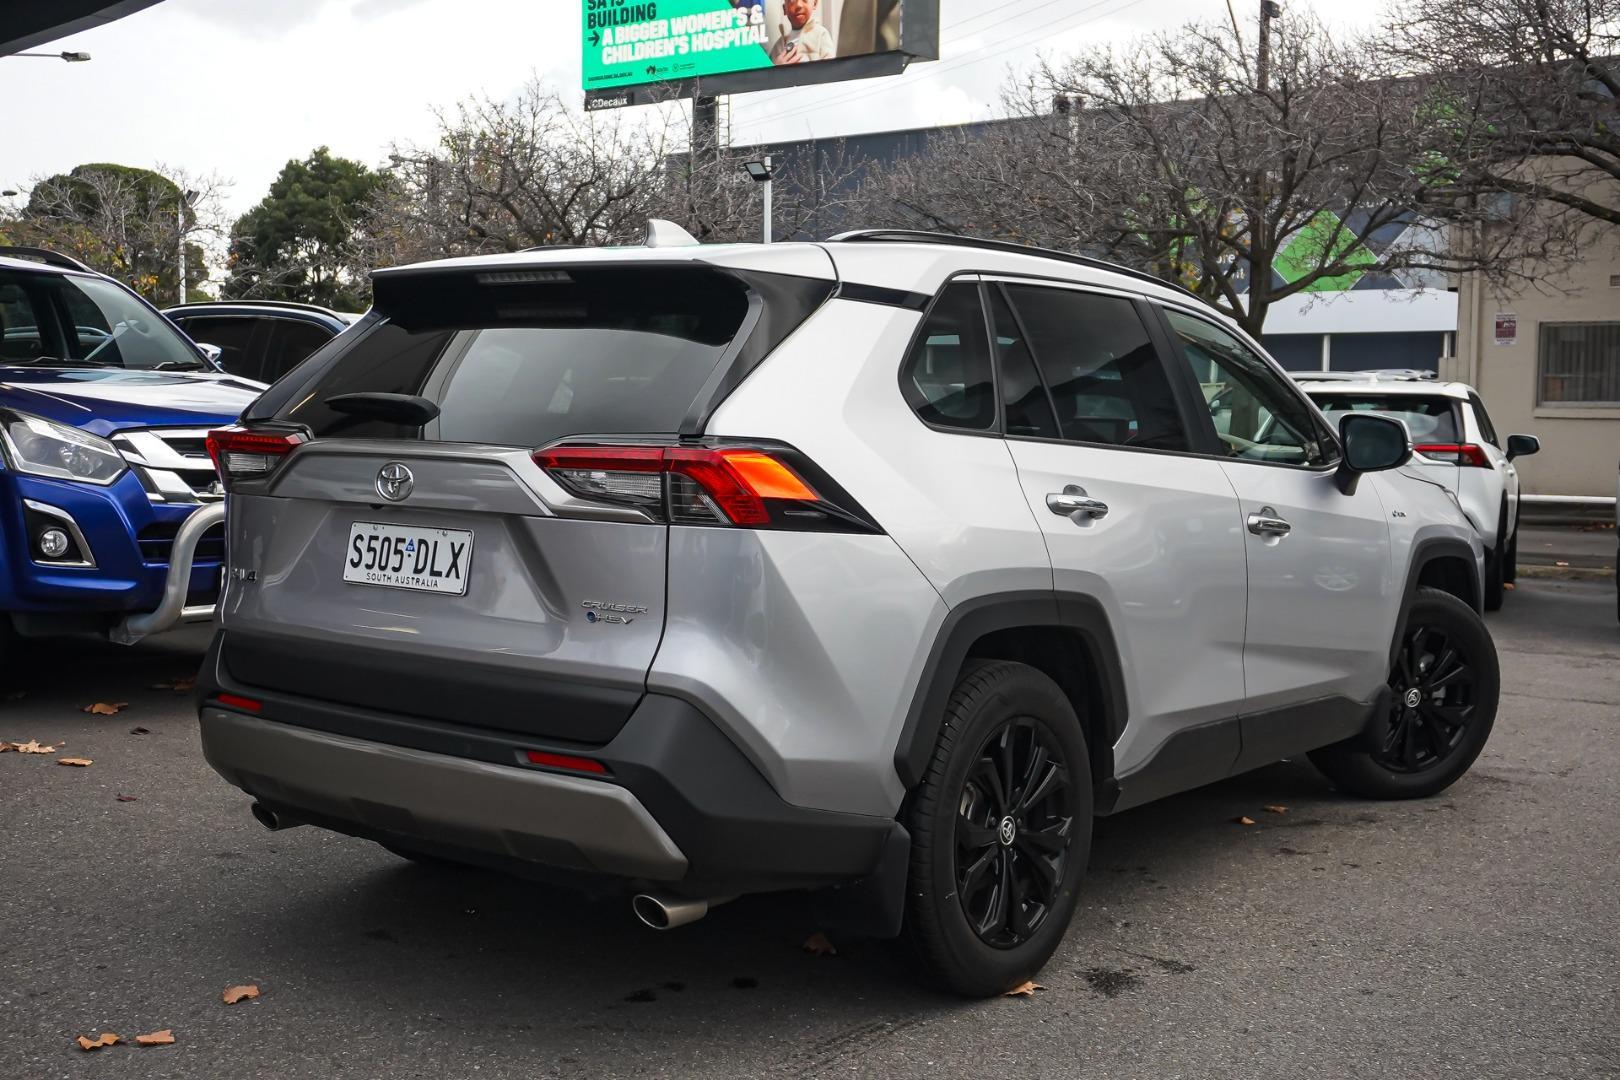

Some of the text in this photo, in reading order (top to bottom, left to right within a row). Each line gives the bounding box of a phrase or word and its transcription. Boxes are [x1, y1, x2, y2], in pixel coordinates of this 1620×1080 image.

[587, 3, 657, 29] BUILDING
[601, 4, 764, 46] A BIGGER WOMEN'S &
[602, 24, 769, 65] CHILDREN'S HOSPITAL
[350, 533, 465, 579] S505 DLX
[366, 572, 439, 588] SOUTH AUSTRALIA
[581, 600, 648, 614] CRUISER
